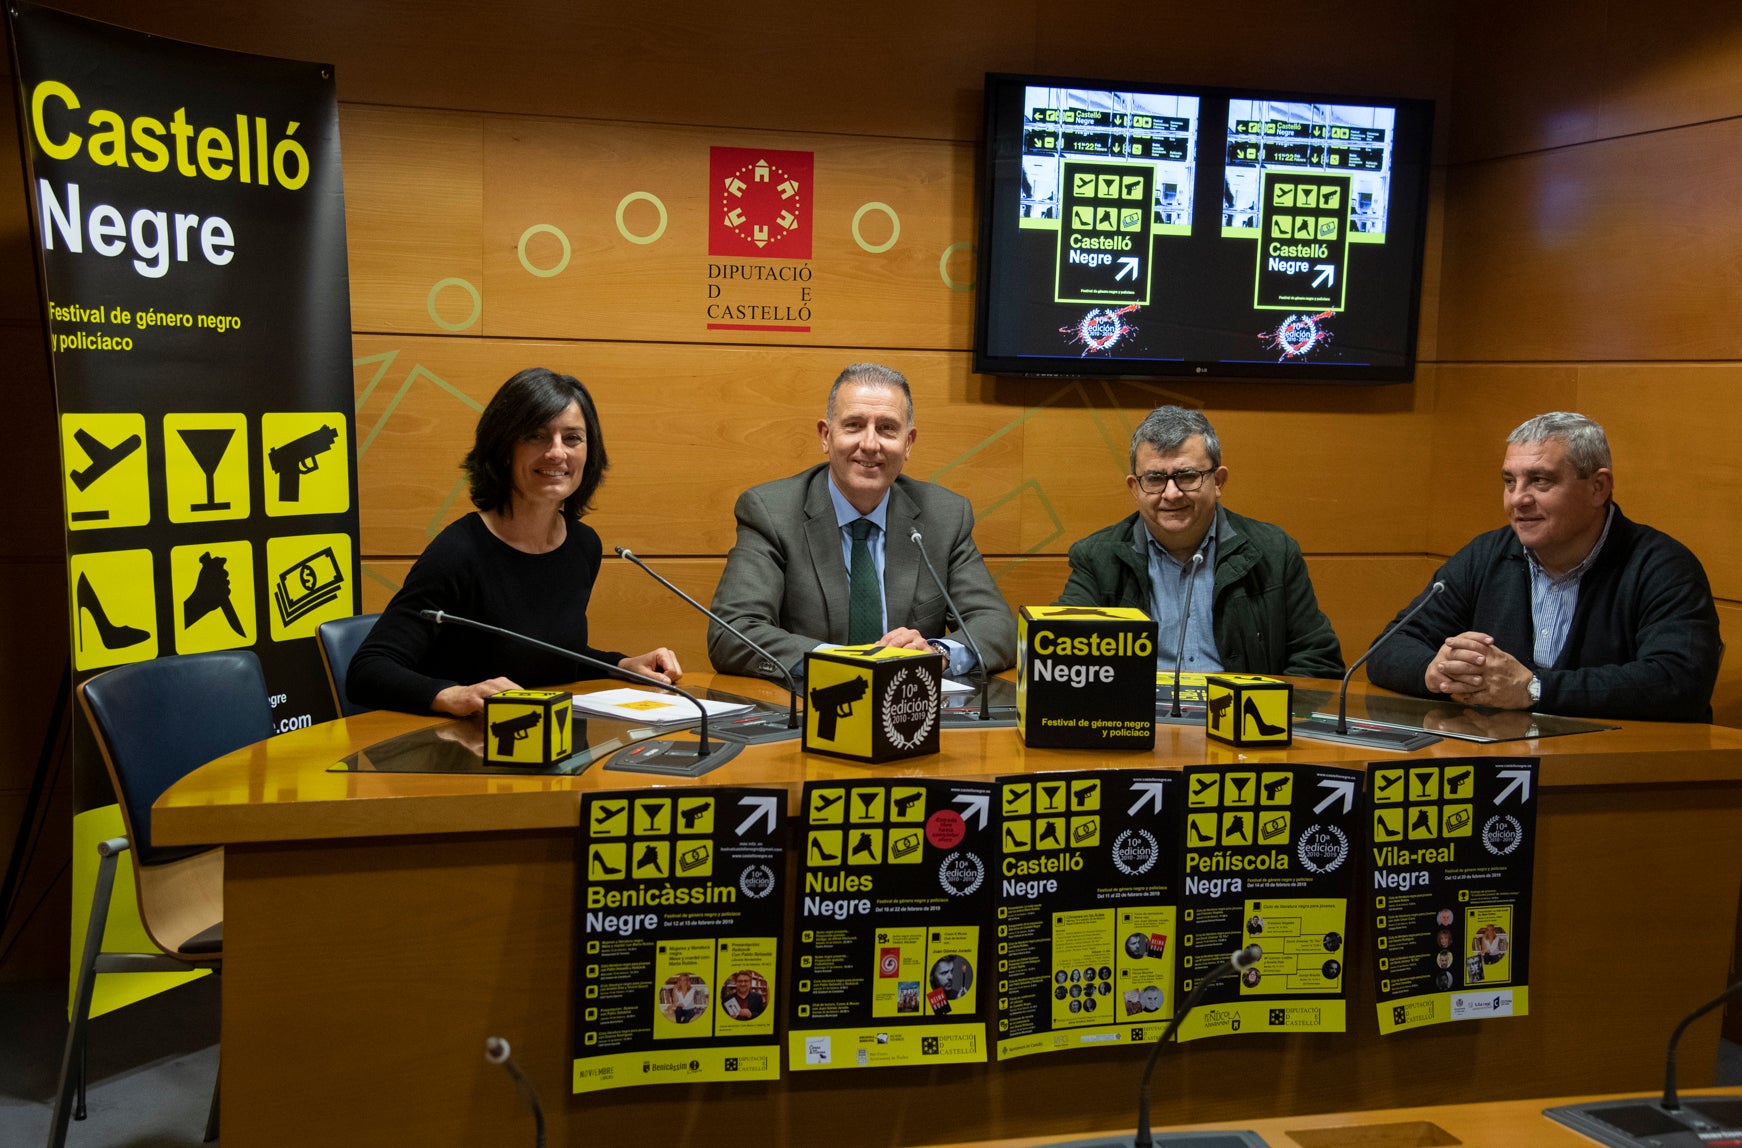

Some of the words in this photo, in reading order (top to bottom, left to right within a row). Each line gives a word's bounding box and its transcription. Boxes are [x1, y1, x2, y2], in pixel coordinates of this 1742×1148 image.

[32, 80, 310, 190] Castelló
[39, 178, 235, 278] Negre
[1070, 234, 1132, 250] Castelló
[1270, 242, 1328, 258] Castelló
[1070, 250, 1112, 267] Negre
[1268, 258, 1309, 274] Negre
[708, 263, 812, 282] DIPUTACIÓ
[49, 301, 105, 323] Festival
[111, 307, 131, 324] de
[136, 308, 194, 329] género
[198, 314, 241, 332] negro
[707, 303, 811, 321] CASTELLÓ
[52, 333, 59, 352] y
[60, 332, 133, 352] policíaco
[1034, 630, 1152, 657] Castelló
[1033, 659, 1115, 688] Negre
[902, 684, 918, 698] 10ª
[890, 698, 928, 715] edición
[892, 713, 906, 724] 2010
[910, 712, 926, 722] 2019
[1042, 718, 1076, 728] Festival
[1078, 718, 1088, 728] de
[1091, 718, 1122, 730] género
[1124, 720, 1150, 730] negro
[1119, 846, 1151, 856] edición
[1305, 843, 1340, 852] edición
[1373, 842, 1455, 867] Vila-real
[1002, 852, 1084, 877] Castelló
[1186, 850, 1288, 873] Peñíscola
[805, 871, 873, 894] Nules
[946, 869, 977, 877] edición
[1374, 870, 1430, 891] Negra
[587, 882, 736, 909] Benicàssim
[1002, 879, 1058, 899] Negre
[1185, 876, 1242, 898] Negra
[803, 896, 871, 921] Negre
[586, 912, 658, 936] Negre
